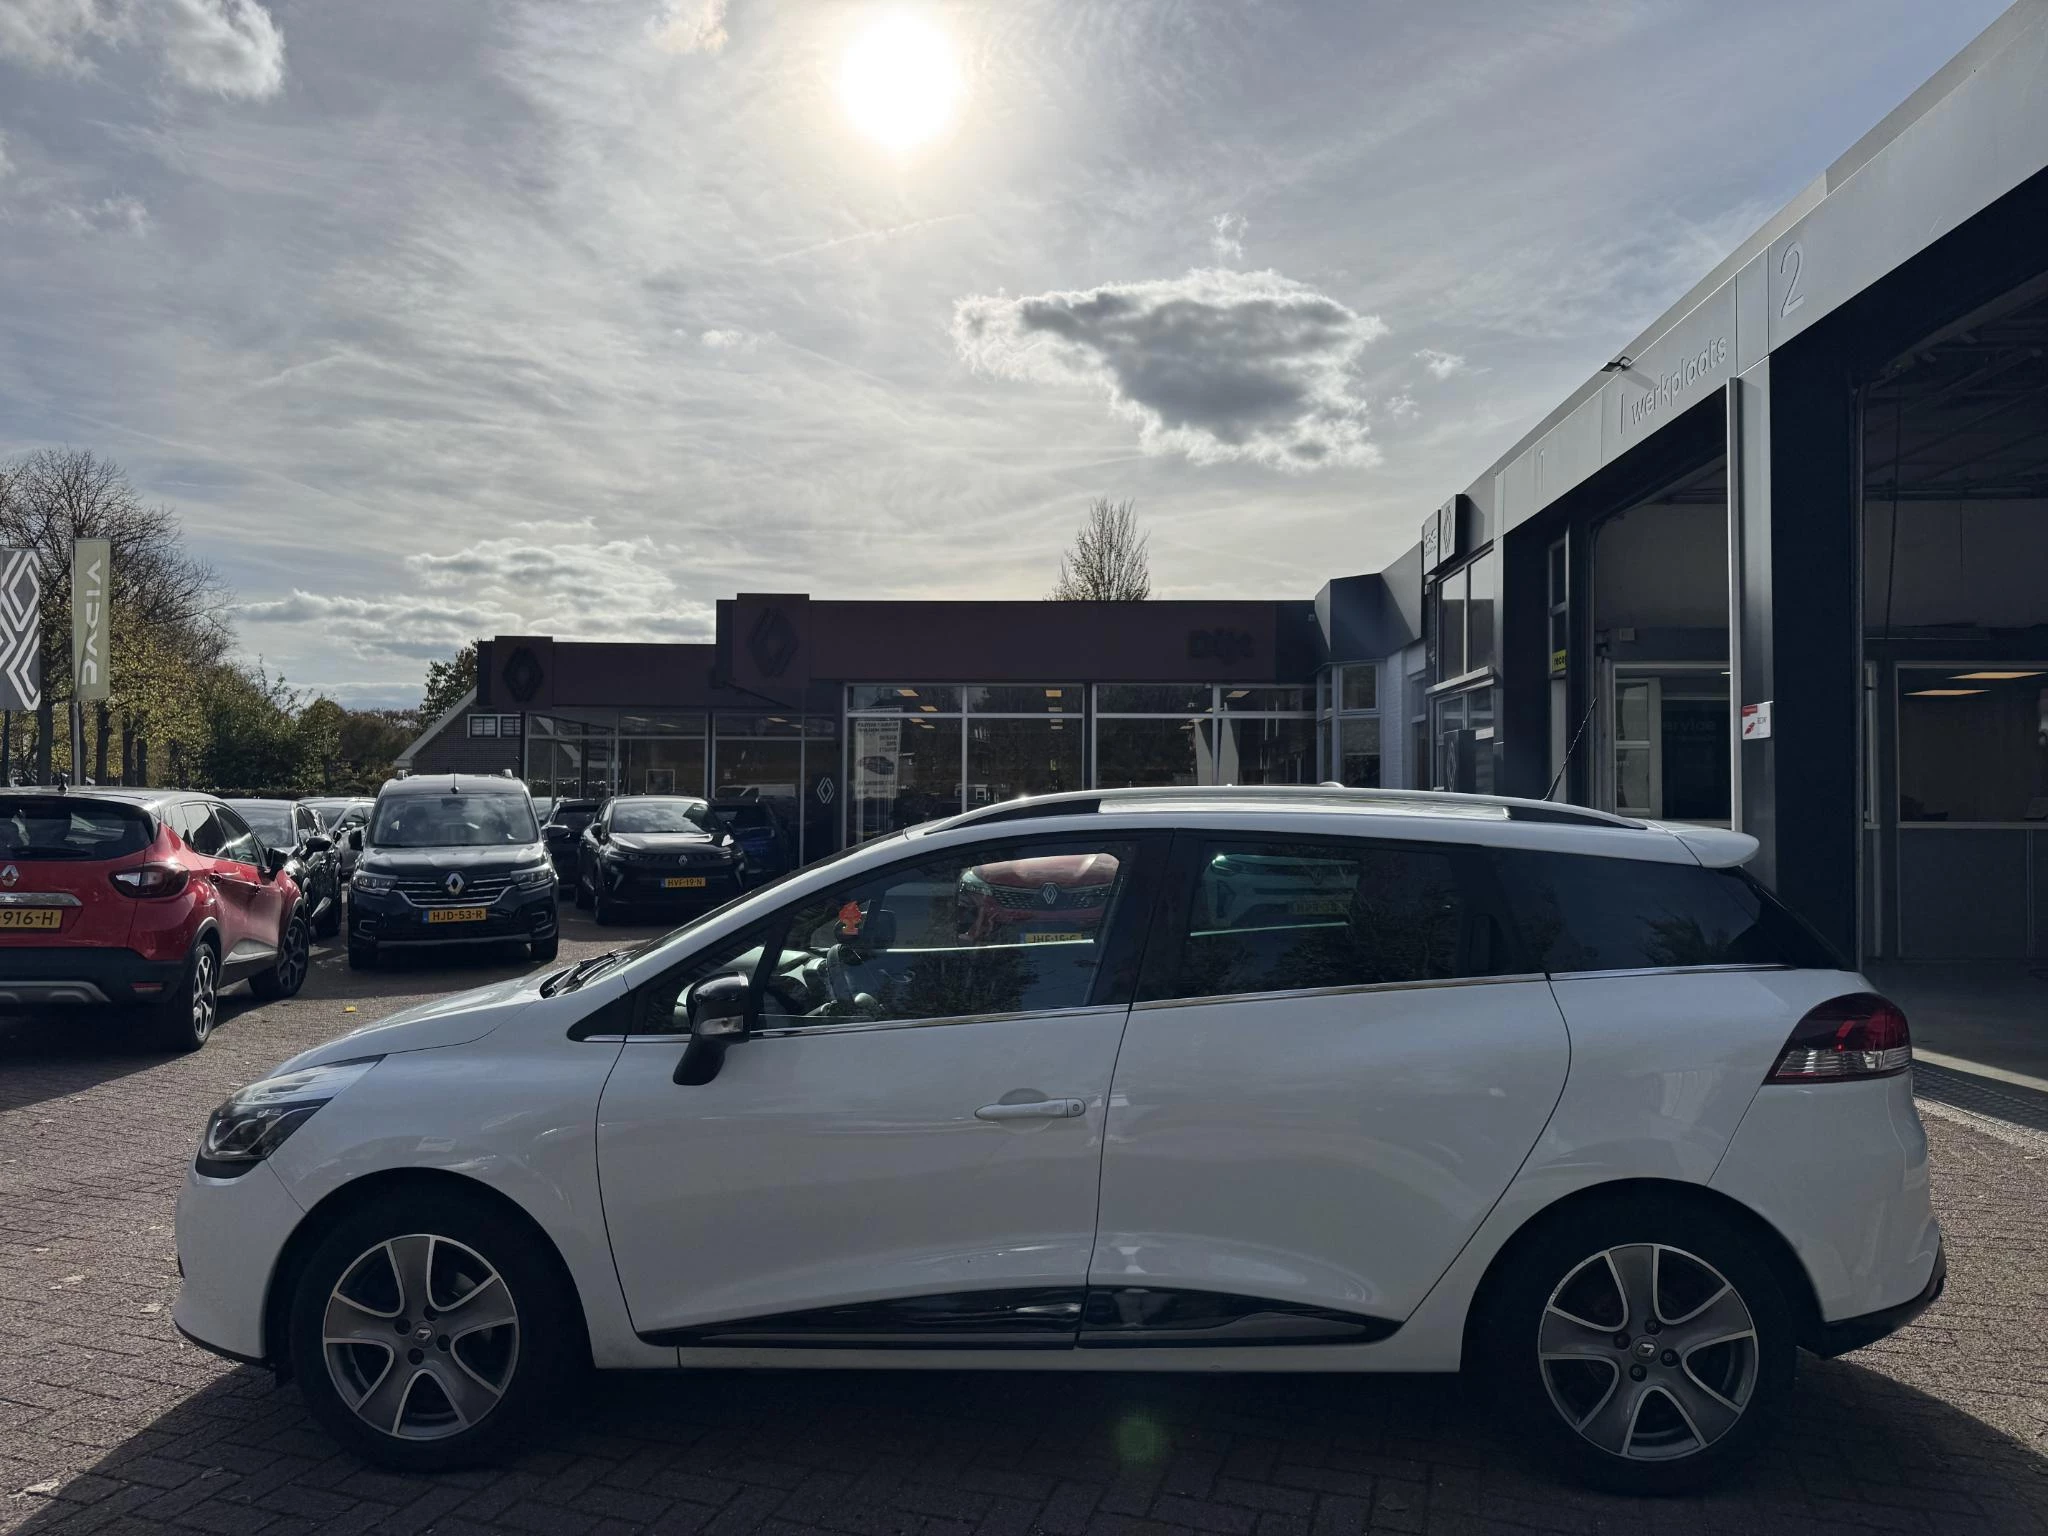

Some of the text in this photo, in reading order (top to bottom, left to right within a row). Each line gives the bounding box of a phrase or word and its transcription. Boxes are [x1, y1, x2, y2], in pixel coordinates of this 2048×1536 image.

[1779, 240, 1805, 319] 2
[1631, 336, 1728, 425] werkplaats
[81, 559, 101, 686] DACIA
[0, 911, 54, 926] 916-H
[432, 910, 483, 921] HJD-53-R
